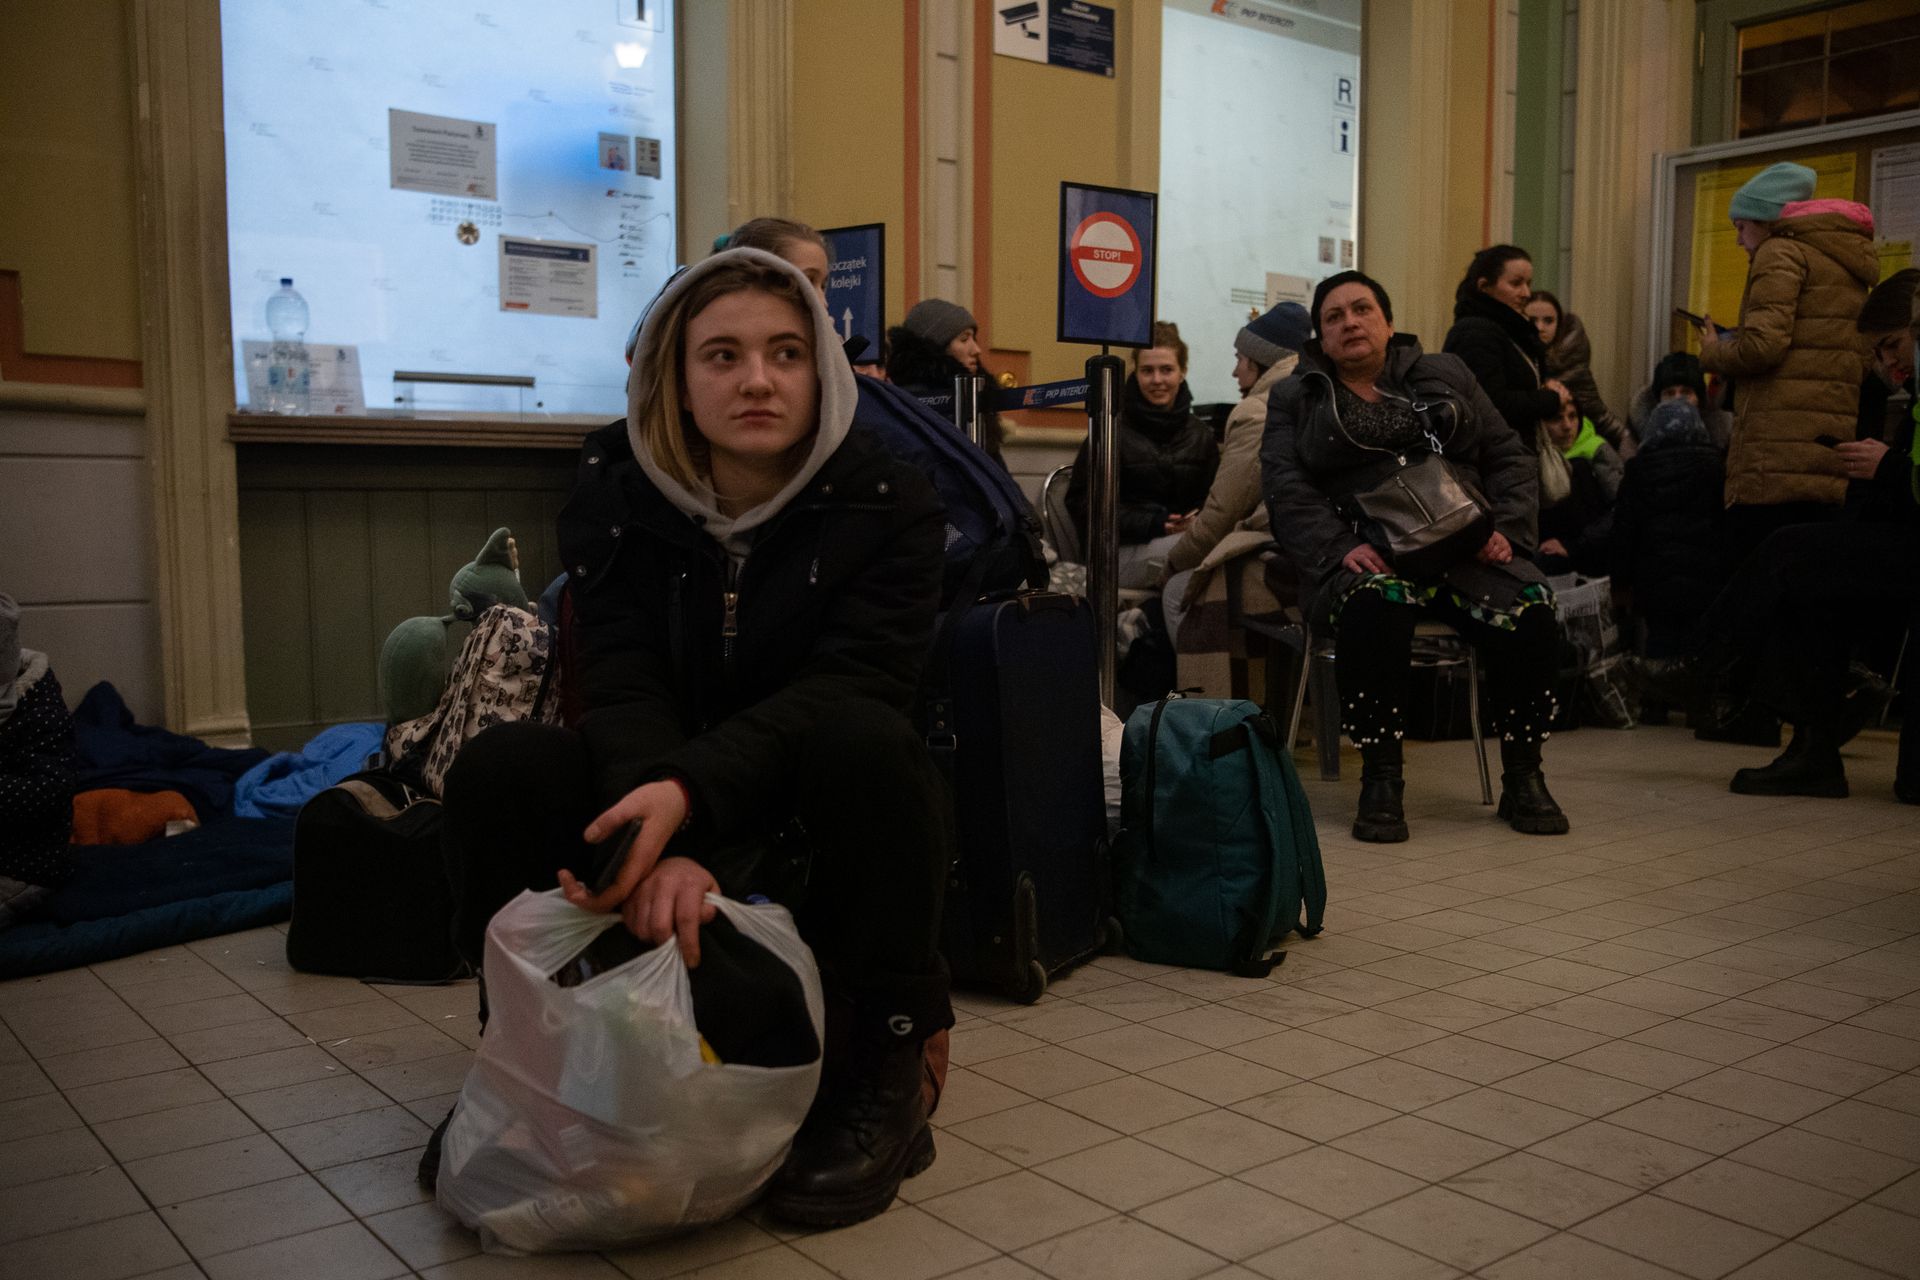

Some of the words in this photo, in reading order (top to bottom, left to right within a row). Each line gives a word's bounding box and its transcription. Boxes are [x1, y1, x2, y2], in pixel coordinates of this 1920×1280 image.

[1338, 78, 1352, 104] R
[831, 256, 868, 272] oczątek
[1093, 249, 1121, 262] STOP!
[831, 274, 862, 290] kolejki
[1044, 389, 1059, 401] PKP
[1059, 383, 1090, 398] INTERCIT
[888, 1015, 913, 1036] G
